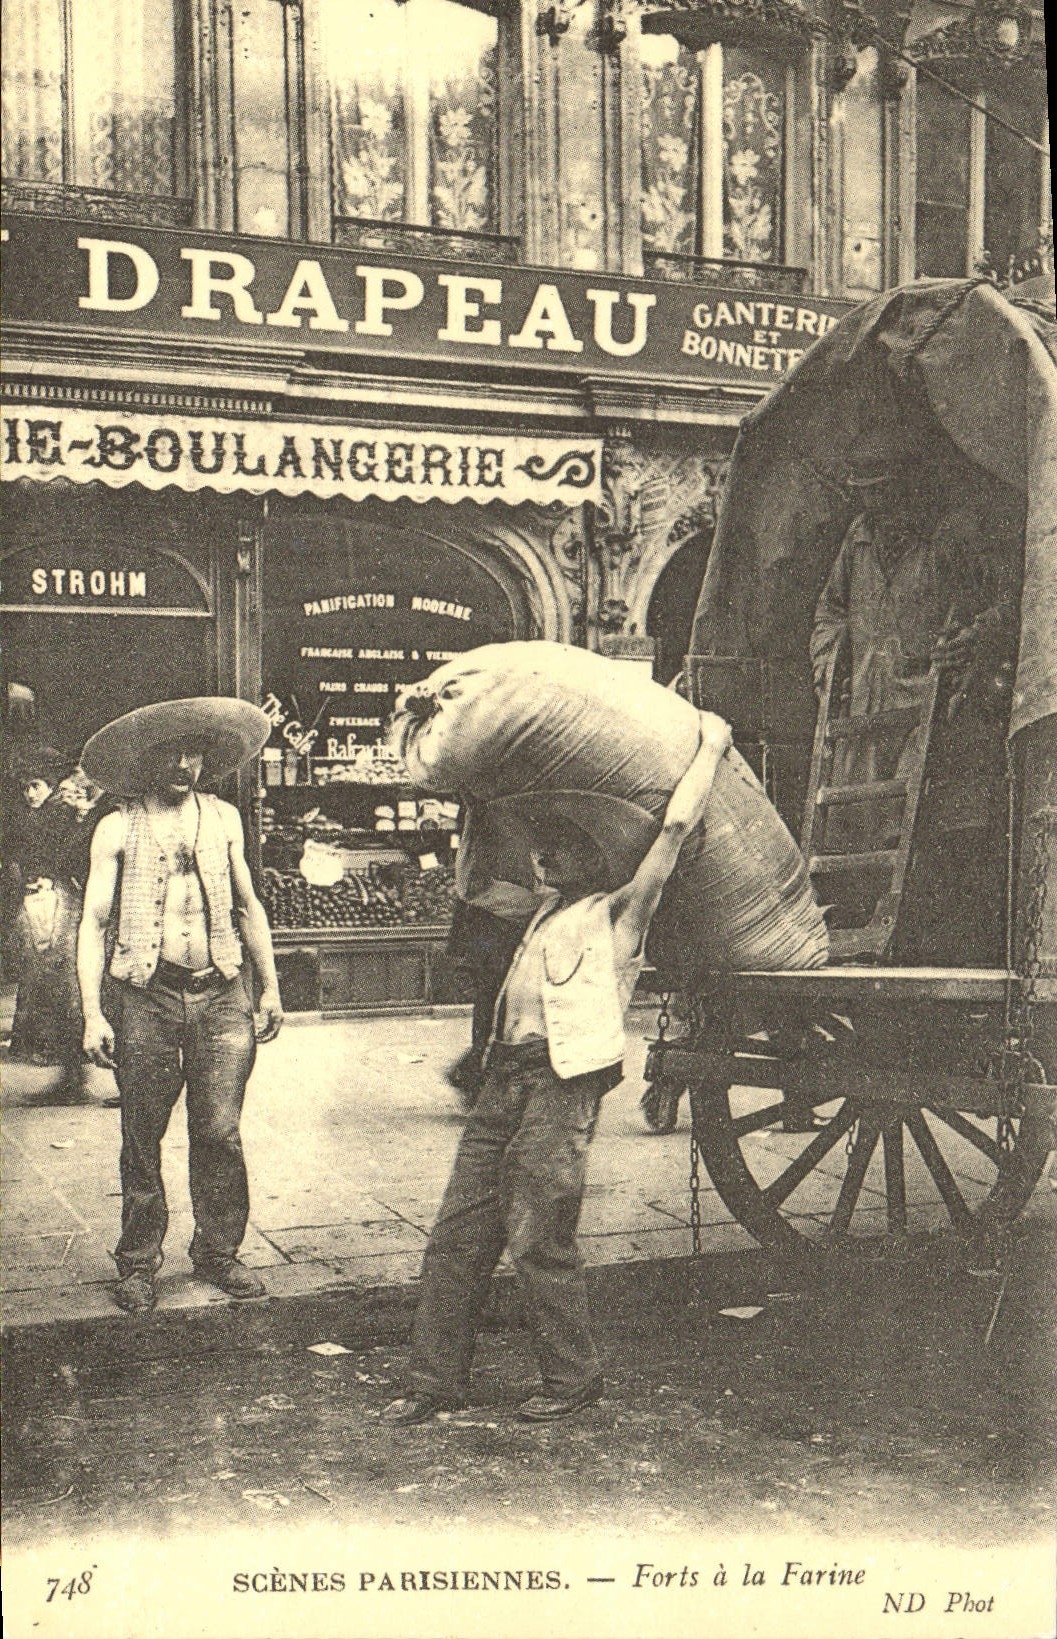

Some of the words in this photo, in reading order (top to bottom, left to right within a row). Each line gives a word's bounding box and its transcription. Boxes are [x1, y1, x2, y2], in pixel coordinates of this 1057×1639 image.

[77, 237, 657, 358] DRAPEAU
[753, 329, 782, 345] ET
[32, 568, 147, 597] STROHM
[303, 593, 395, 617] PANIFICATION
[411, 597, 473, 621] MODERNE
